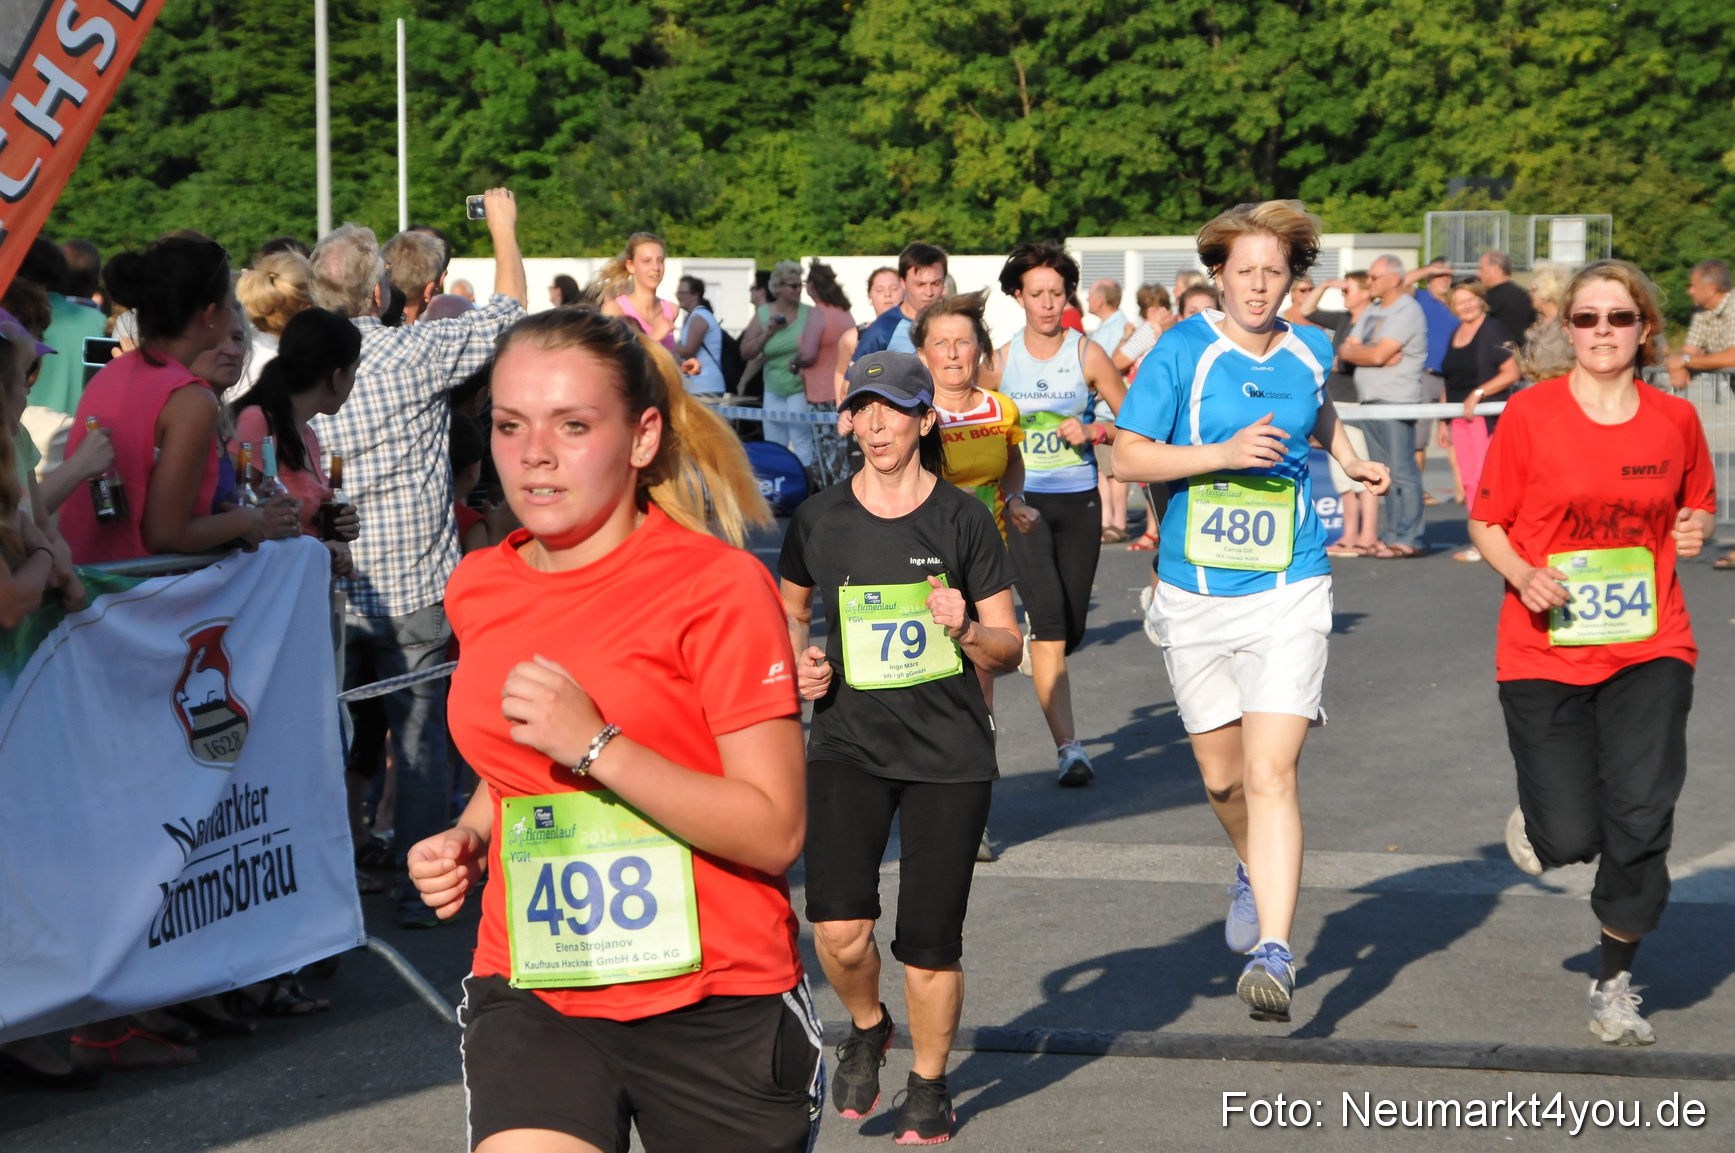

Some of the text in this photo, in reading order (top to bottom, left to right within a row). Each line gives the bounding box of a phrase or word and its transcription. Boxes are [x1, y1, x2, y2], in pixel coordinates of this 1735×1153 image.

[1265, 391, 1294, 399] classic
[942, 432, 966, 443] AX
[1022, 430, 1071, 454] 120
[1621, 464, 1658, 476] swn
[1201, 507, 1276, 546] 480
[909, 557, 926, 566] Inge
[857, 602, 897, 612] firmenlauf
[871, 620, 927, 661] 79
[904, 661, 919, 669] März
[905, 668, 926, 678] gGmbH
[203, 731, 242, 760] 1628
[526, 824, 577, 841] firmenlauf
[580, 830, 618, 845] 2014
[526, 856, 658, 936] 498
[556, 939, 633, 953] Elena Strojanov
[524, 949, 681, 970] Kaufhaus Hackner GmbH & Co. KG
